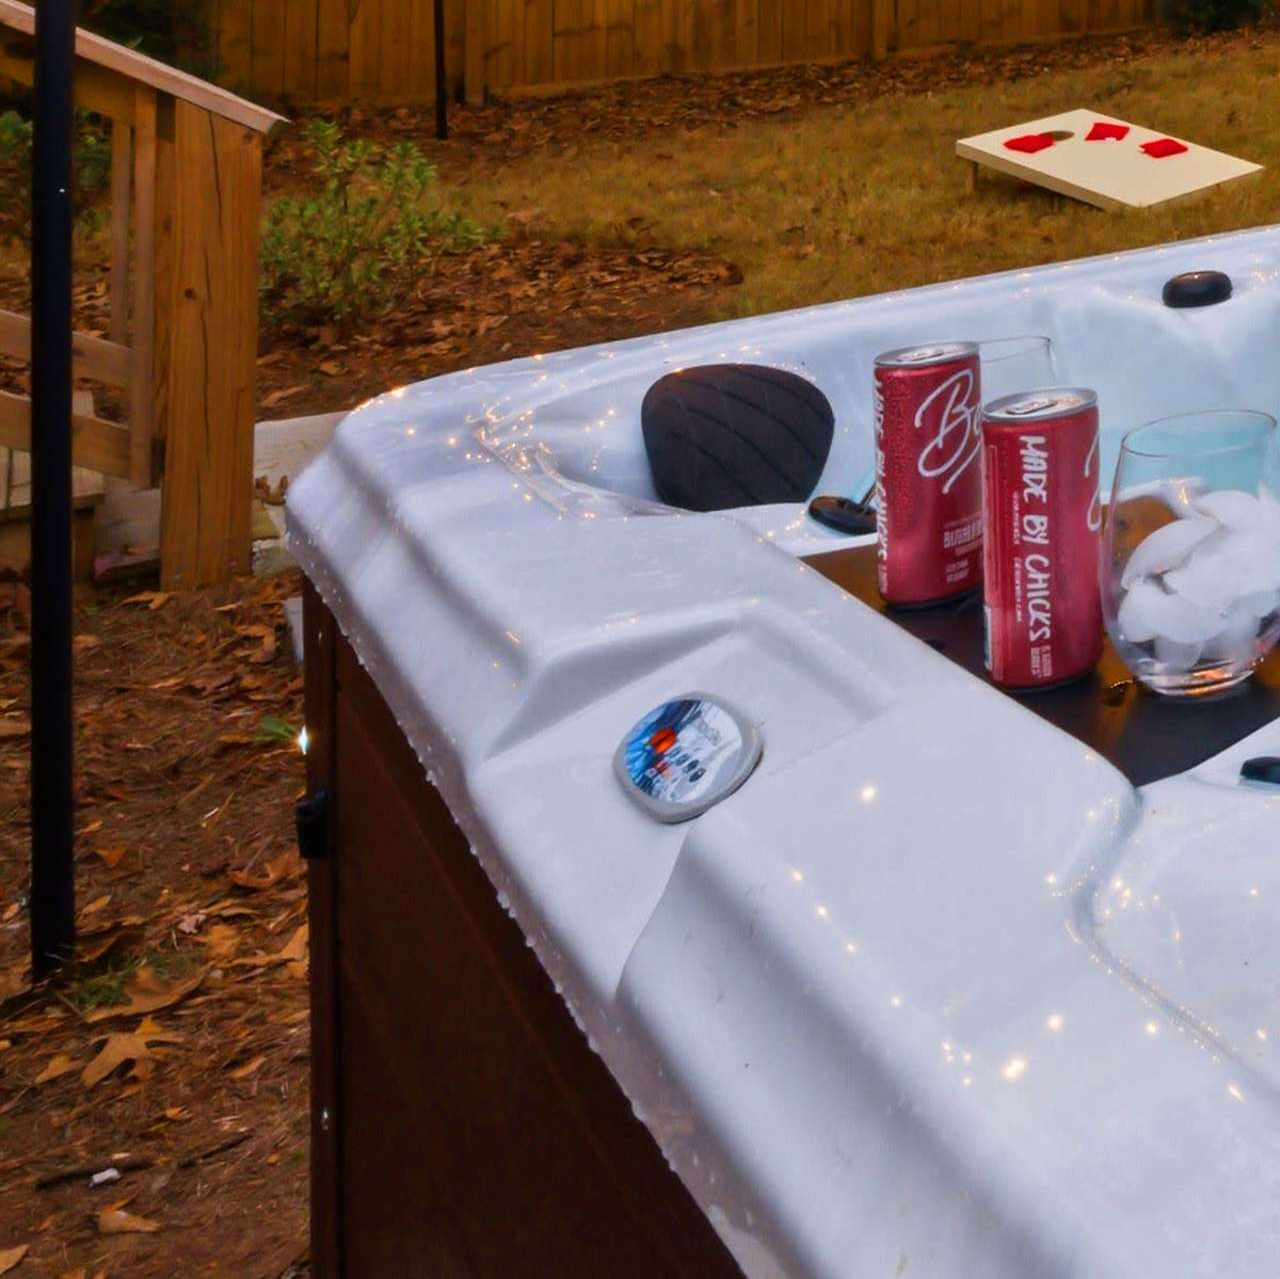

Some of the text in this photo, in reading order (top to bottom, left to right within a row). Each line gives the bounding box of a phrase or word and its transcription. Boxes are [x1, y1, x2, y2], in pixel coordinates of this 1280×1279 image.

[1019, 435, 1049, 504] MADE
[1022, 514, 1049, 544] BY
[1024, 553, 1051, 642] CHICKS
